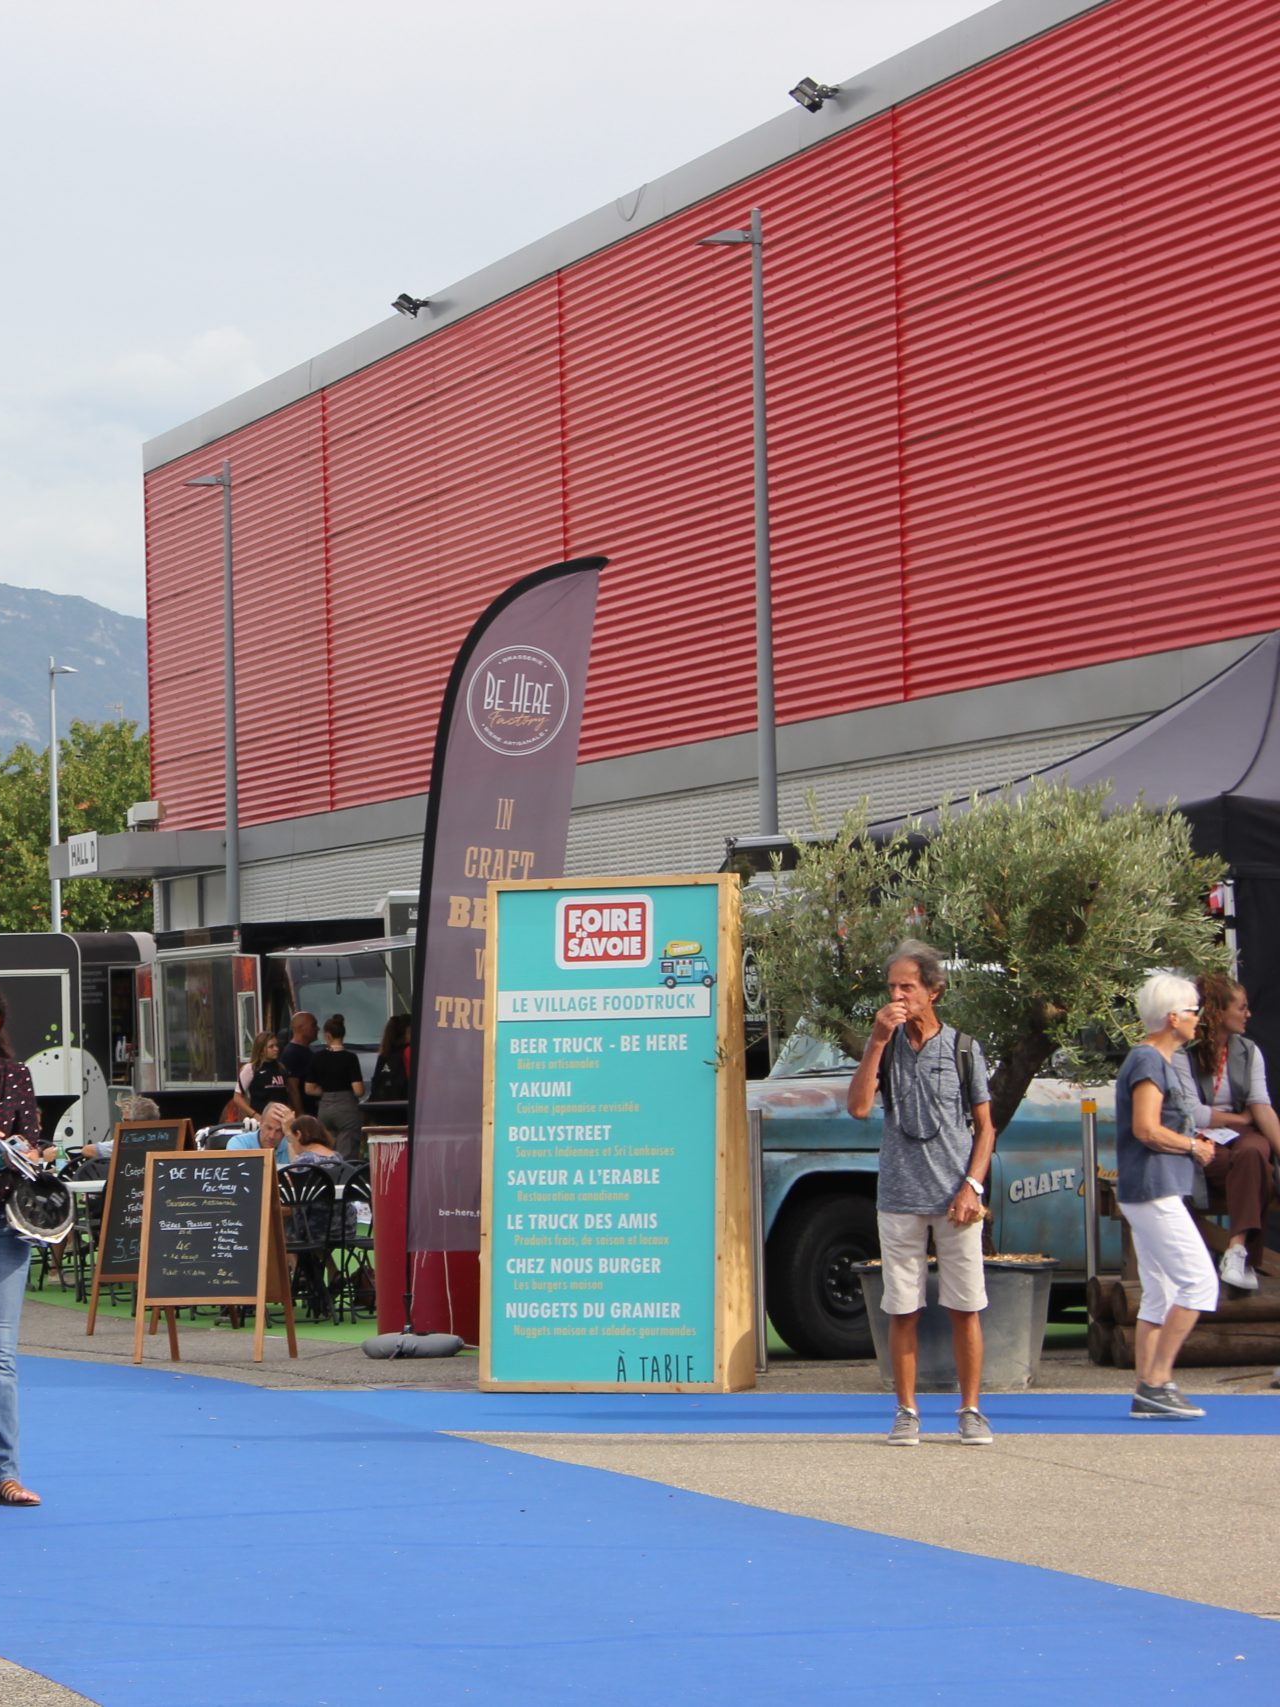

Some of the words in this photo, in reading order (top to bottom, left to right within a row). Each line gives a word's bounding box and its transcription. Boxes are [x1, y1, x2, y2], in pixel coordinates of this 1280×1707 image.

[502, 655, 544, 666] BRASSERIE
[483, 671, 506, 711] BE
[509, 673, 554, 715] HERE
[495, 798, 514, 830] IN
[71, 842, 88, 867] HALL
[90, 840, 95, 863] D
[464, 846, 534, 881] CRAFT
[447, 896, 487, 930] BE
[568, 908, 642, 933] FOIRE
[576, 928, 588, 938] de
[568, 936, 641, 958] SAVOIE
[512, 998, 528, 1013] LE
[534, 996, 597, 1012] VILLAGE
[603, 993, 696, 1011] FOODTRUCK
[435, 995, 485, 1031] TRU
[510, 1038, 548, 1054] BEER
[552, 1036, 603, 1053] TRUCK
[620, 1035, 640, 1052] BE
[646, 1033, 688, 1051] HERE
[509, 1081, 571, 1098] YAKUMI
[516, 1102, 549, 1114] Cuisine
[508, 1124, 612, 1142] BOLLYSTREET
[602, 1146, 612, 1157] et
[169, 1167, 188, 1180] BE
[194, 1167, 231, 1181] HERE
[507, 1170, 568, 1186] SAVEUR
[573, 1169, 584, 1185] A
[589, 1168, 661, 1185] L'ERABLE
[1009, 1168, 1076, 1203] CRAFT
[438, 1208, 480, 1217] be-here.f
[506, 1214, 523, 1230] LE
[528, 1214, 579, 1230] TRUCK
[584, 1213, 612, 1230] DES
[617, 1213, 658, 1229] AMIS
[112, 1237, 139, 1259] 3,5
[581, 1234, 592, 1245] de
[627, 1235, 637, 1245] et
[506, 1258, 545, 1274] CHEZ
[550, 1258, 593, 1274] NOUS
[598, 1257, 661, 1273] BURGER
[513, 1279, 529, 1290] Les
[505, 1302, 578, 1318] NUGGETS
[583, 1302, 605, 1318] DU
[610, 1302, 681, 1319] GRANIER
[589, 1325, 599, 1336] et
[617, 1349, 627, 1382] À
